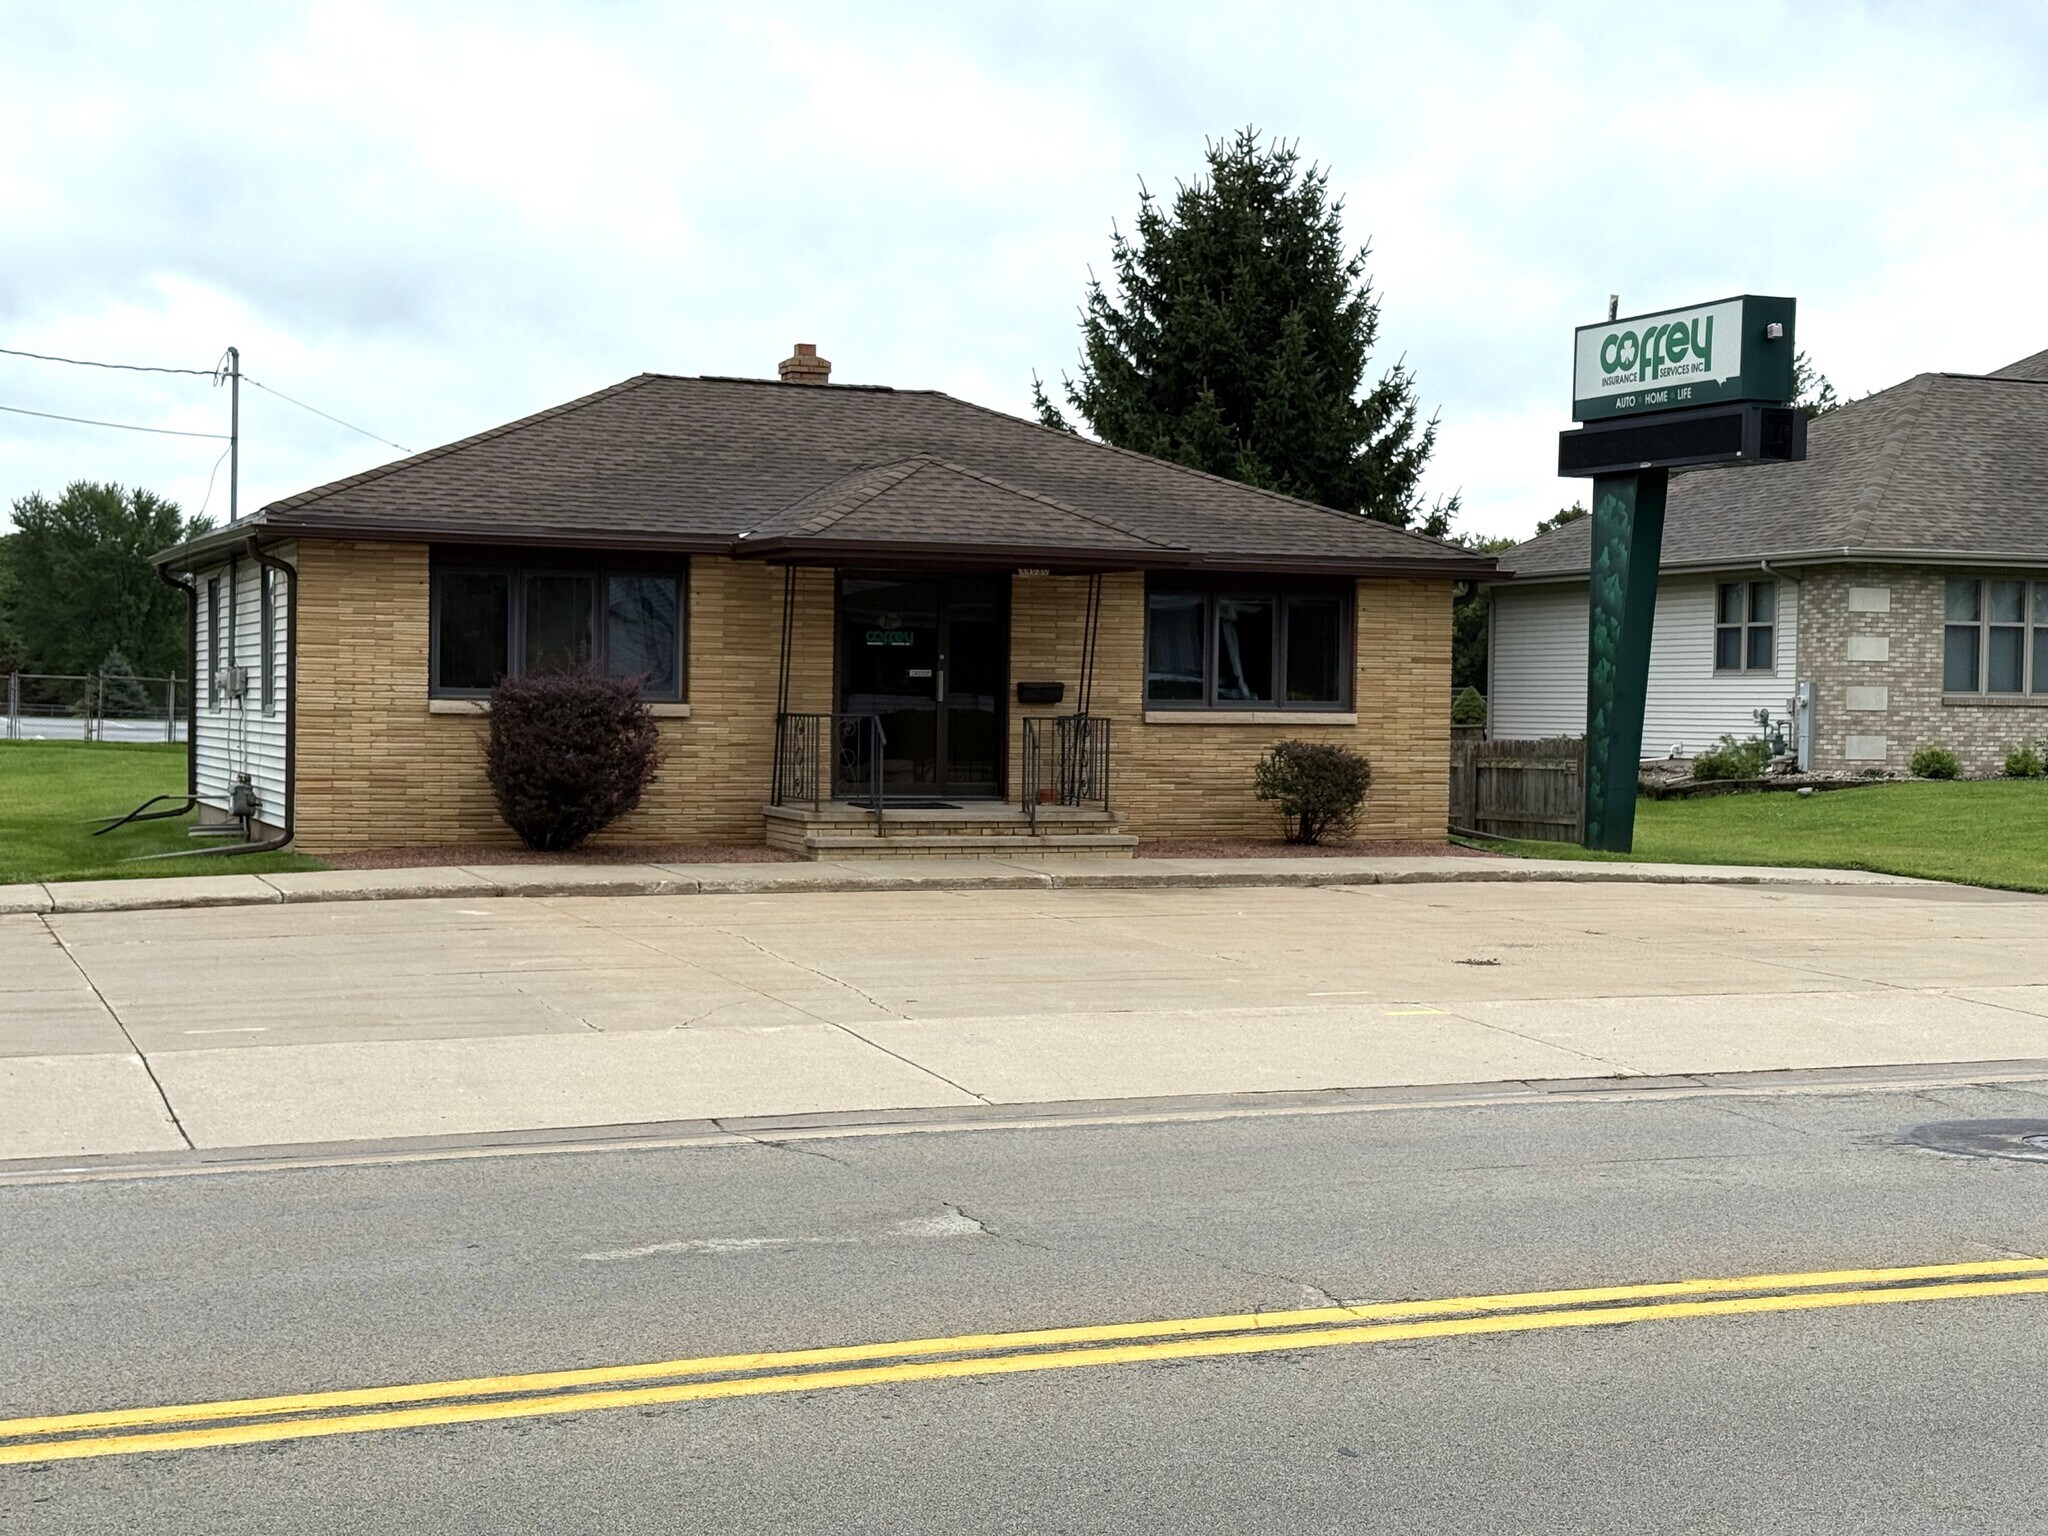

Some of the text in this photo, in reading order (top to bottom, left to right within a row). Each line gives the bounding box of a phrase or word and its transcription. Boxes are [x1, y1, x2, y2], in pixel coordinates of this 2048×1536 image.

[1600, 315, 1714, 382] coffey
[1602, 362, 1704, 387] INSURANCE SERVICES INC
[1615, 387, 1692, 408] AUTO HOME LIFE
